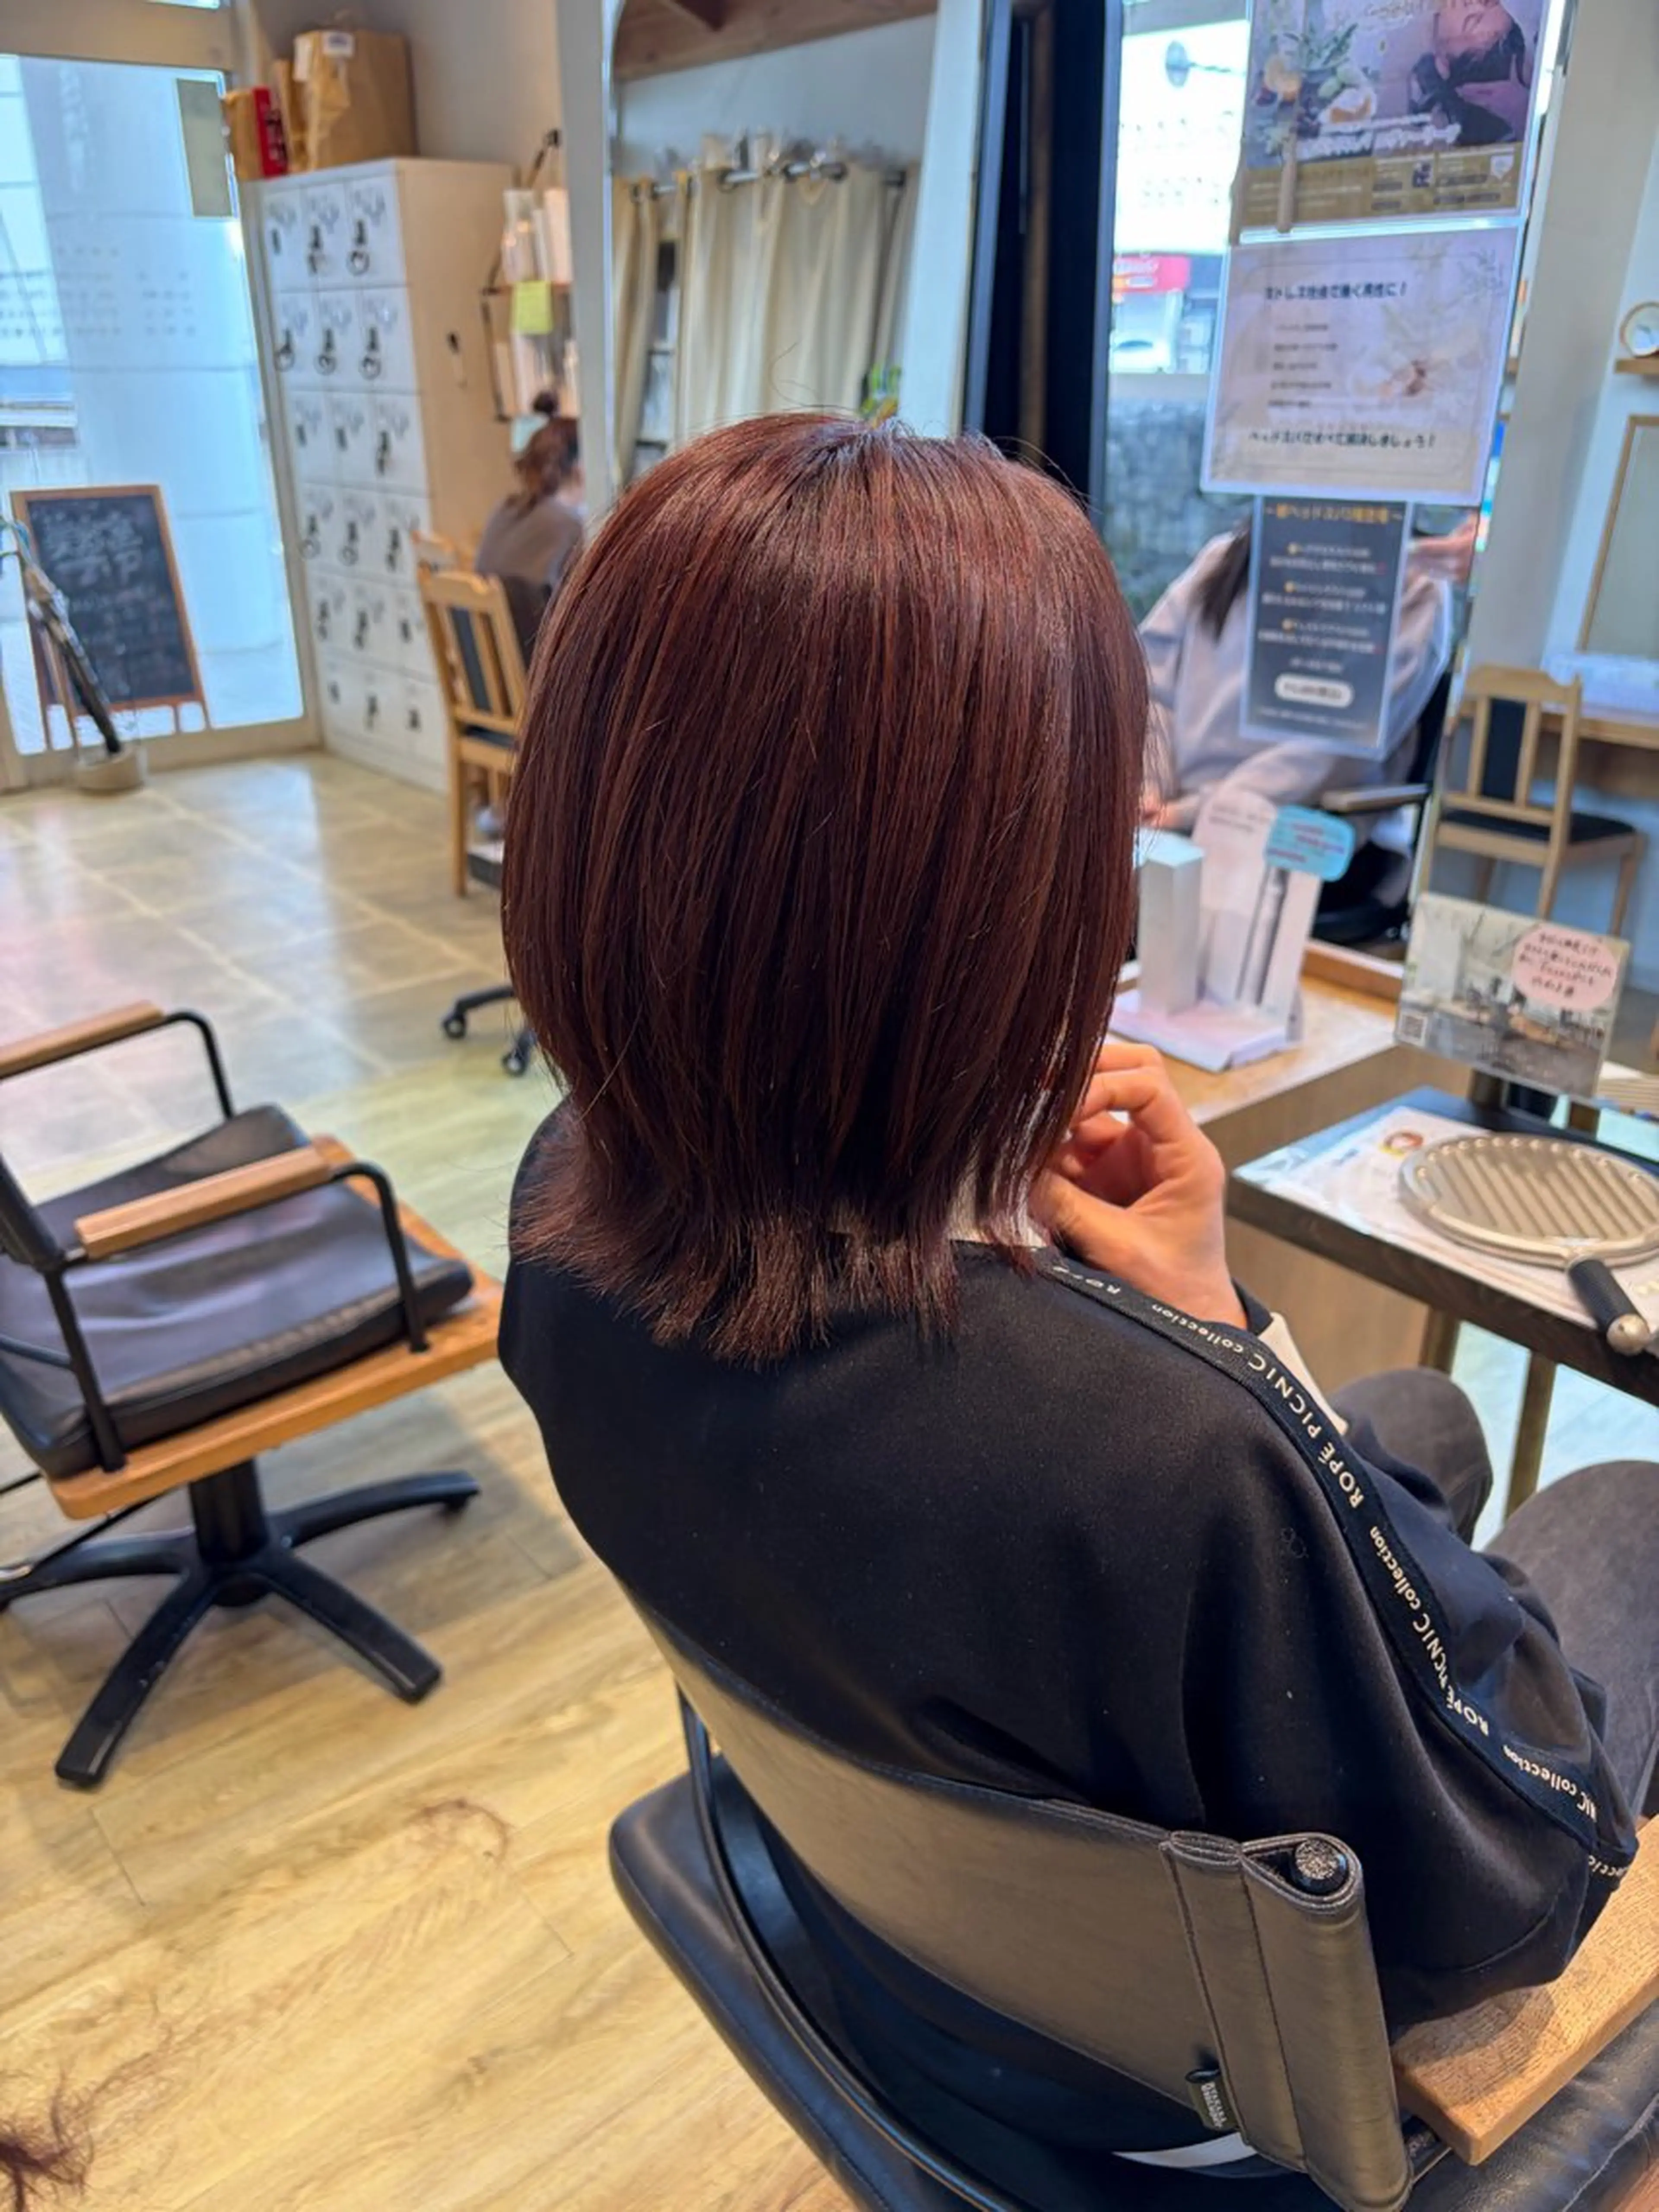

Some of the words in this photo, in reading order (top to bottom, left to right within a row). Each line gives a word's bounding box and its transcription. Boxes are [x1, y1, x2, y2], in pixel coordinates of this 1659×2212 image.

[1152, 1304, 1243, 1354] collection
[1248, 1354, 1322, 1439] PICNIC
[1317, 1442, 1365, 1508] ROPÉ
[1370, 1526, 1421, 1610] collection
[1412, 1612, 1448, 1689] PICNIC
[1503, 1744, 1577, 1796] collection
